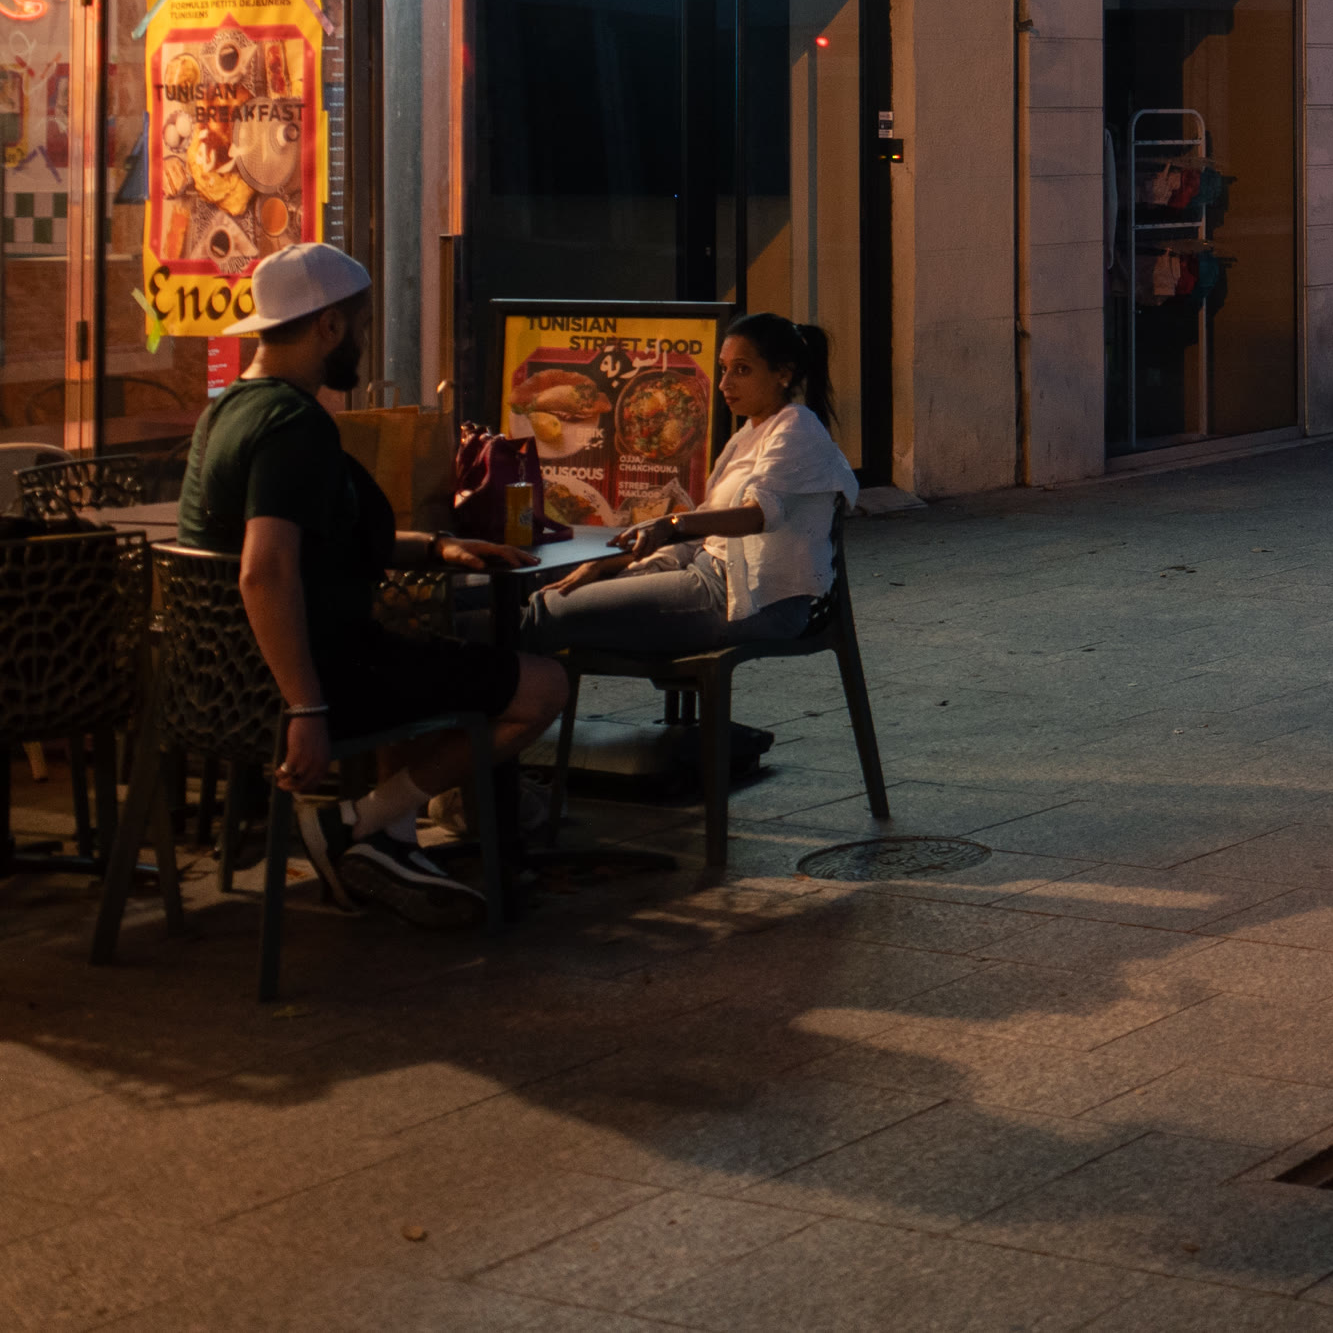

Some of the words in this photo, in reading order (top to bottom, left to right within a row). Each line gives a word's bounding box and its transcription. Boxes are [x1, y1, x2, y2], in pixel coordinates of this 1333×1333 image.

[170, 0, 211, 11] FORMULES
[212, 0, 239, 9] PETITS
[170, 10, 209, 20] TUNISIENS
[153, 83, 238, 104] TUNISIAN
[195, 102, 307, 124] BREAKFAST
[526, 316, 617, 333] TUNISIAN
[568, 335, 641, 353] STREET
[645, 338, 703, 356] FOOD
[619, 463, 679, 474] CHAKCHOUKA
[618, 481, 649, 490] STREET
